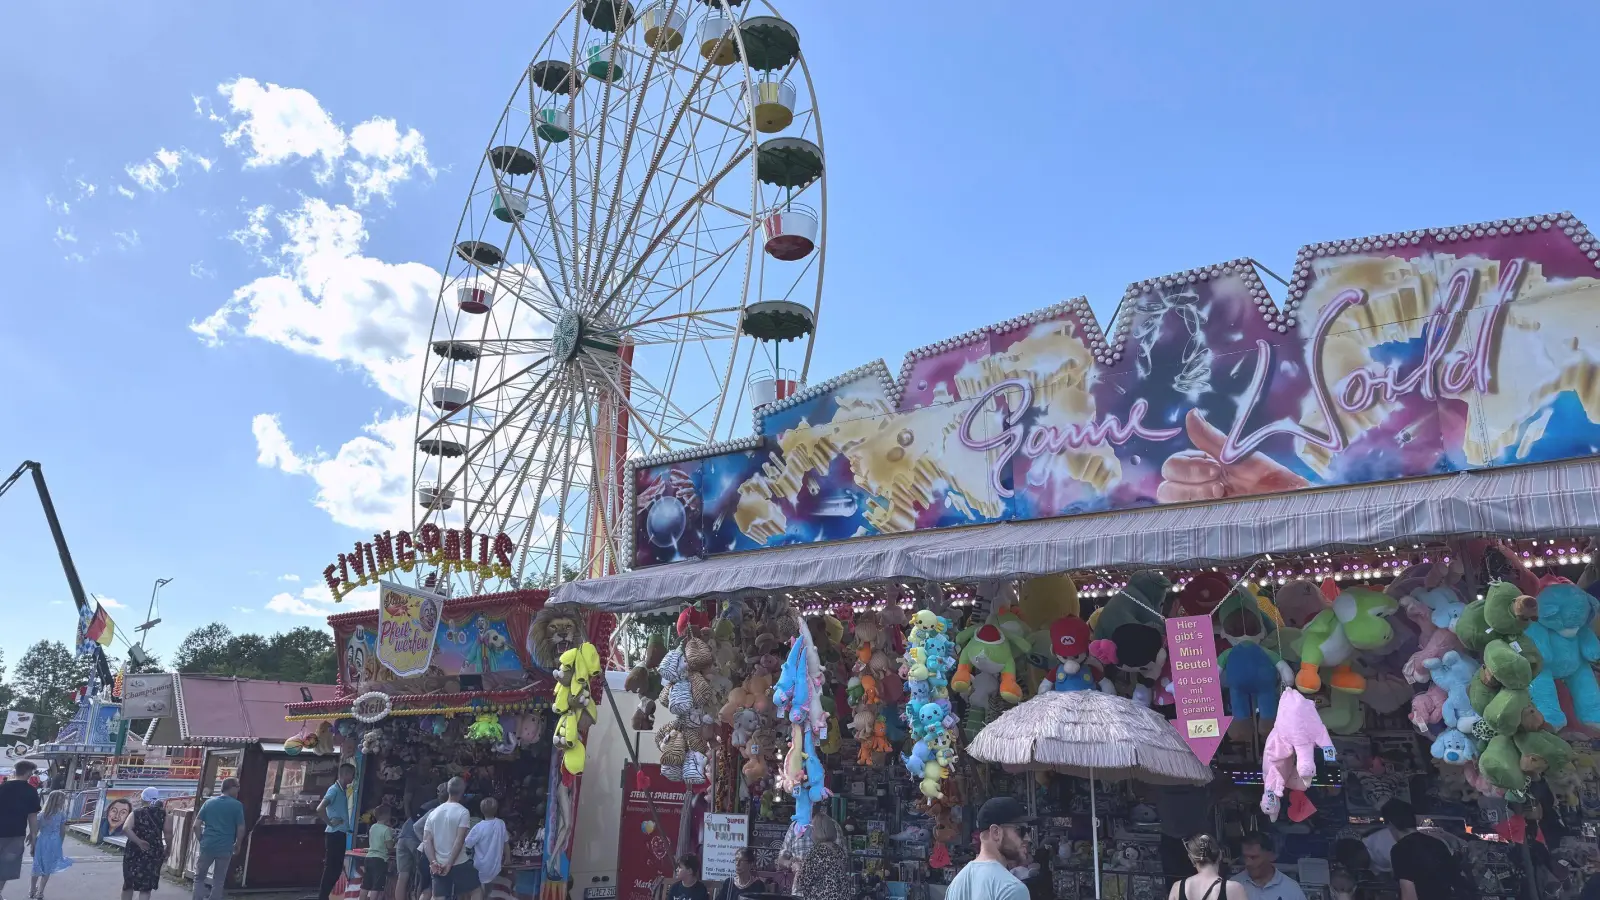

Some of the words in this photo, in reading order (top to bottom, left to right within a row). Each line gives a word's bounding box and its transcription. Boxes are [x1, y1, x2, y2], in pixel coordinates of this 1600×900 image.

[960, 378, 1182, 498] Game
[1219, 258, 1526, 465] World
[1177, 621, 1197, 629] Hier
[395, 629, 428, 655] werfen
[1180, 646, 1203, 656] Mini
[1175, 658, 1211, 671] Beutel
[1177, 677, 1188, 685] 40
[1190, 676, 1213, 685] Lose
[124, 683, 172, 700] Champignons
[360, 699, 385, 714] Steib
[1183, 705, 1215, 715] garantie
[706, 822, 730, 832] TUTTI
[715, 832, 744, 842] FRUTTI
